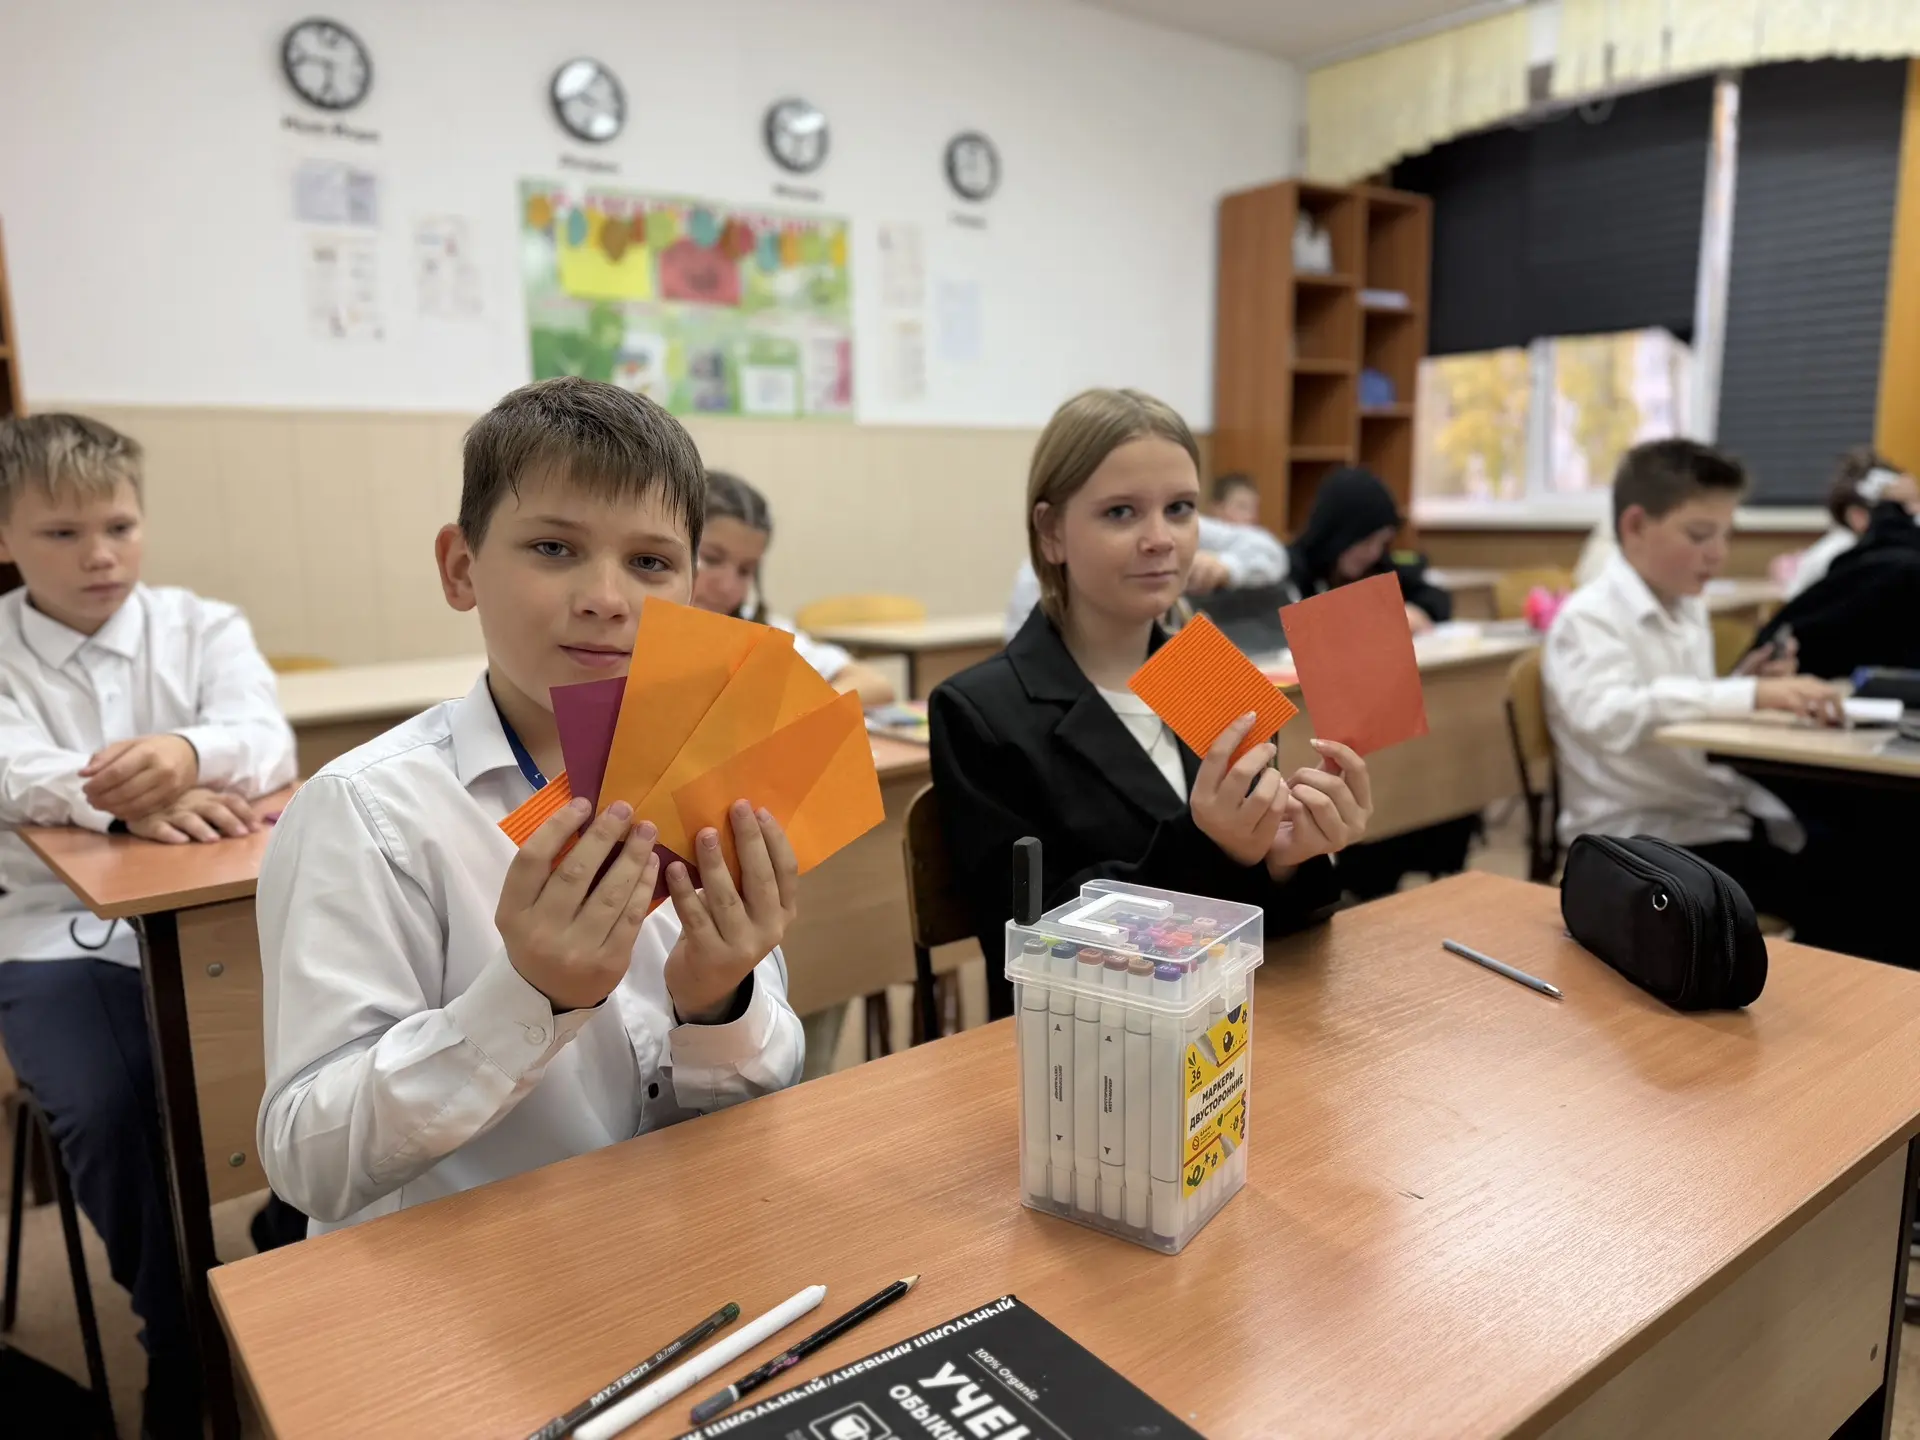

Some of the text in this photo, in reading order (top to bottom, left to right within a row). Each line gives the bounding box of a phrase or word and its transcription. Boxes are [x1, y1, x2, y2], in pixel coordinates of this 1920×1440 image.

[1191, 1066, 1201, 1085] 36
[1202, 1066, 1235, 1104] МАРКЕРЫ
[1190, 1073, 1244, 1132] ДВУСТОРОННИЕ
[589, 1361, 650, 1407] MY-TECH
[974, 1347, 1040, 1402] 100% Organic
